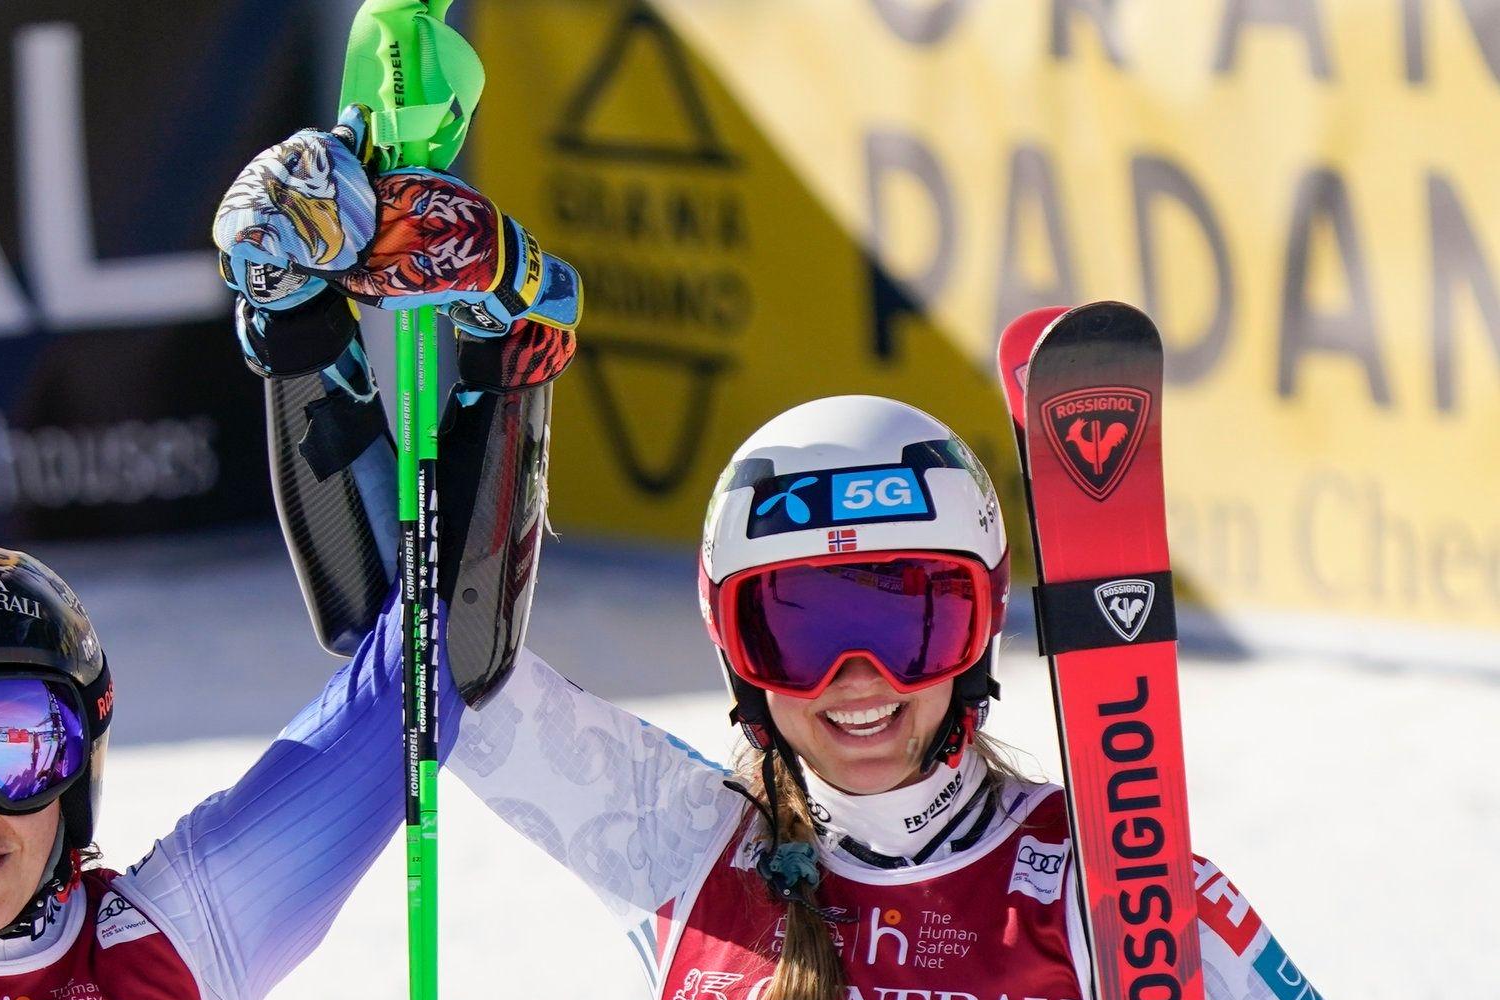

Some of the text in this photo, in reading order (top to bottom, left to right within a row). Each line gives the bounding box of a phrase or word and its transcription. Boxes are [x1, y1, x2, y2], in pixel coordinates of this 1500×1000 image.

[1056, 396, 1136, 420] ROSSIGNOL
[841, 477, 913, 510] 5G
[1102, 584, 1148, 600] ROSSIGNOL
[410, 727, 418, 797] KOMPERDELL
[921, 911, 952, 924] The
[919, 926, 978, 942] Human
[916, 940, 970, 958] Safety
[914, 955, 944, 969] Net
